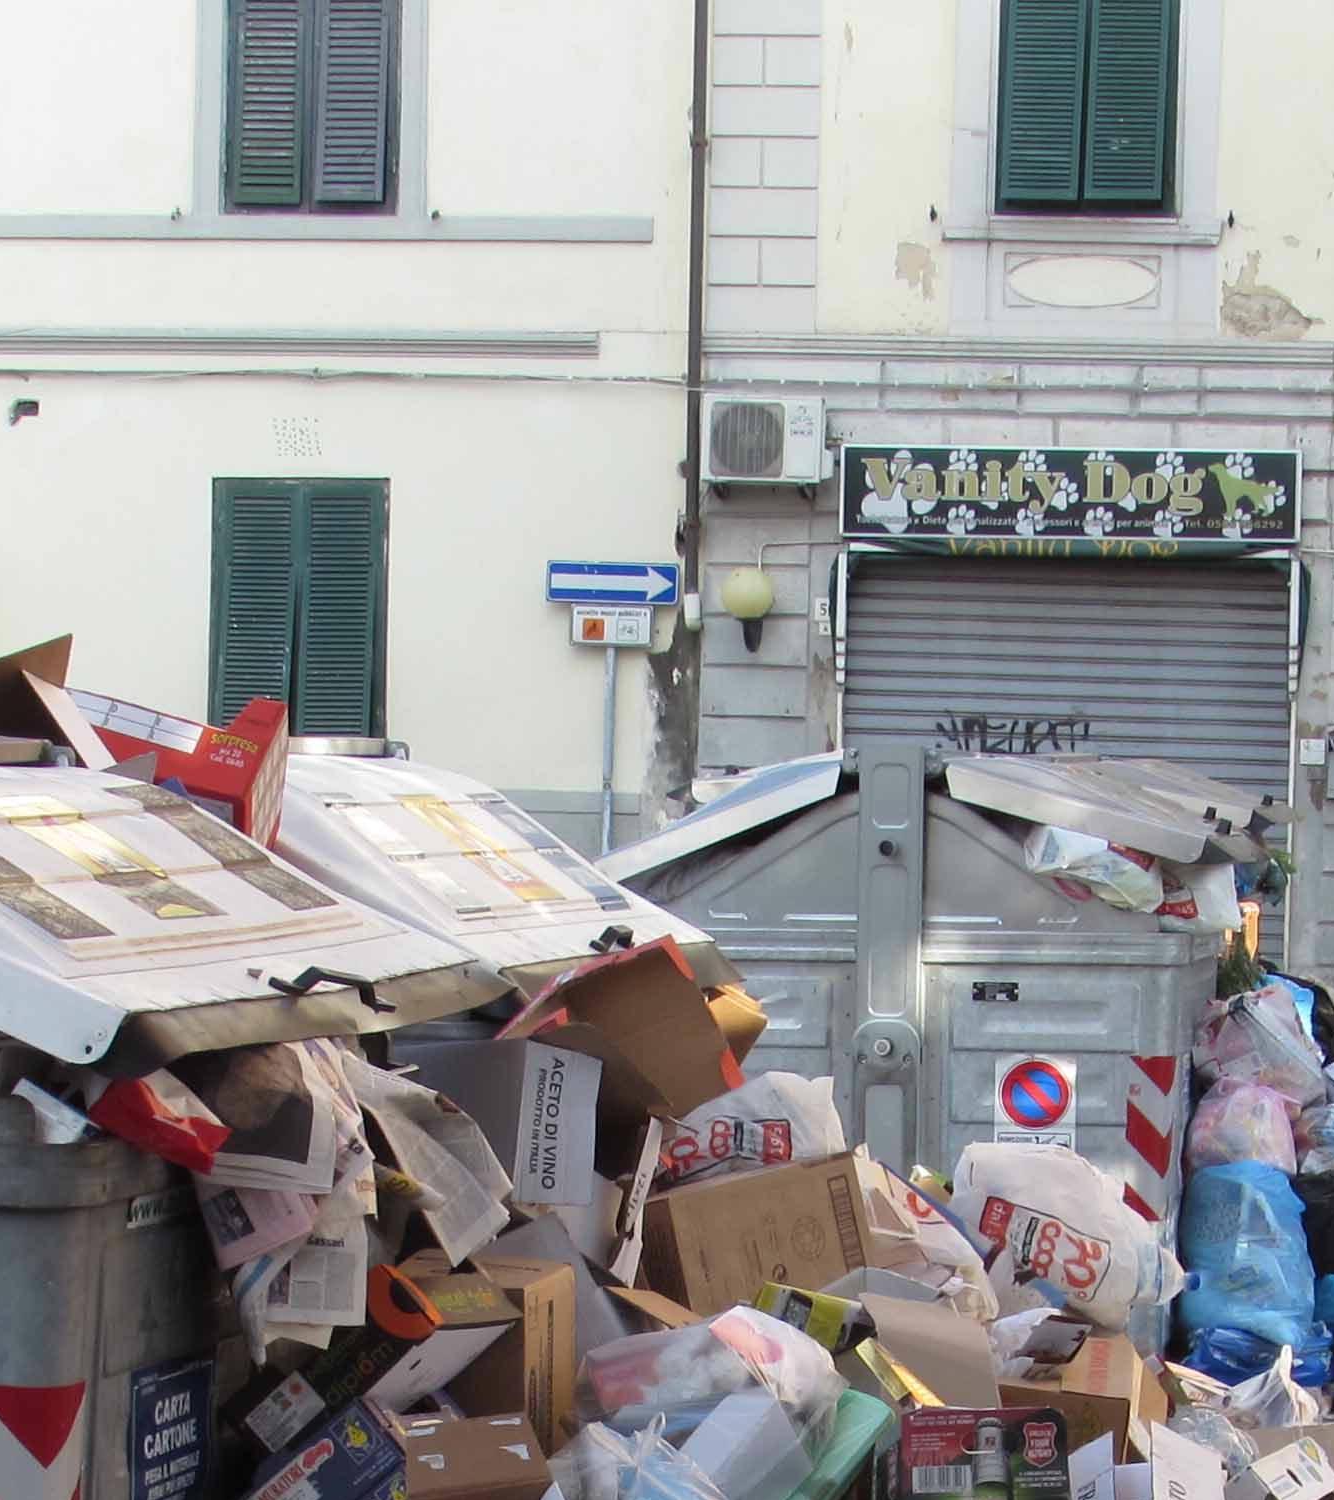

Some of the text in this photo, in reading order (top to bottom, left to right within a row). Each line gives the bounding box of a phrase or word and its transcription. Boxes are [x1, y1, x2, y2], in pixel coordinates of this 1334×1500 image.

[861, 458, 1207, 517] Vanity Dog
[528, 1067, 548, 1175] PRODOTTO IN ITALIA
[541, 1056, 565, 1191] ACETO DI VINO
[154, 1391, 191, 1426] CARTA
[143, 1418, 198, 1459] CARTONE
